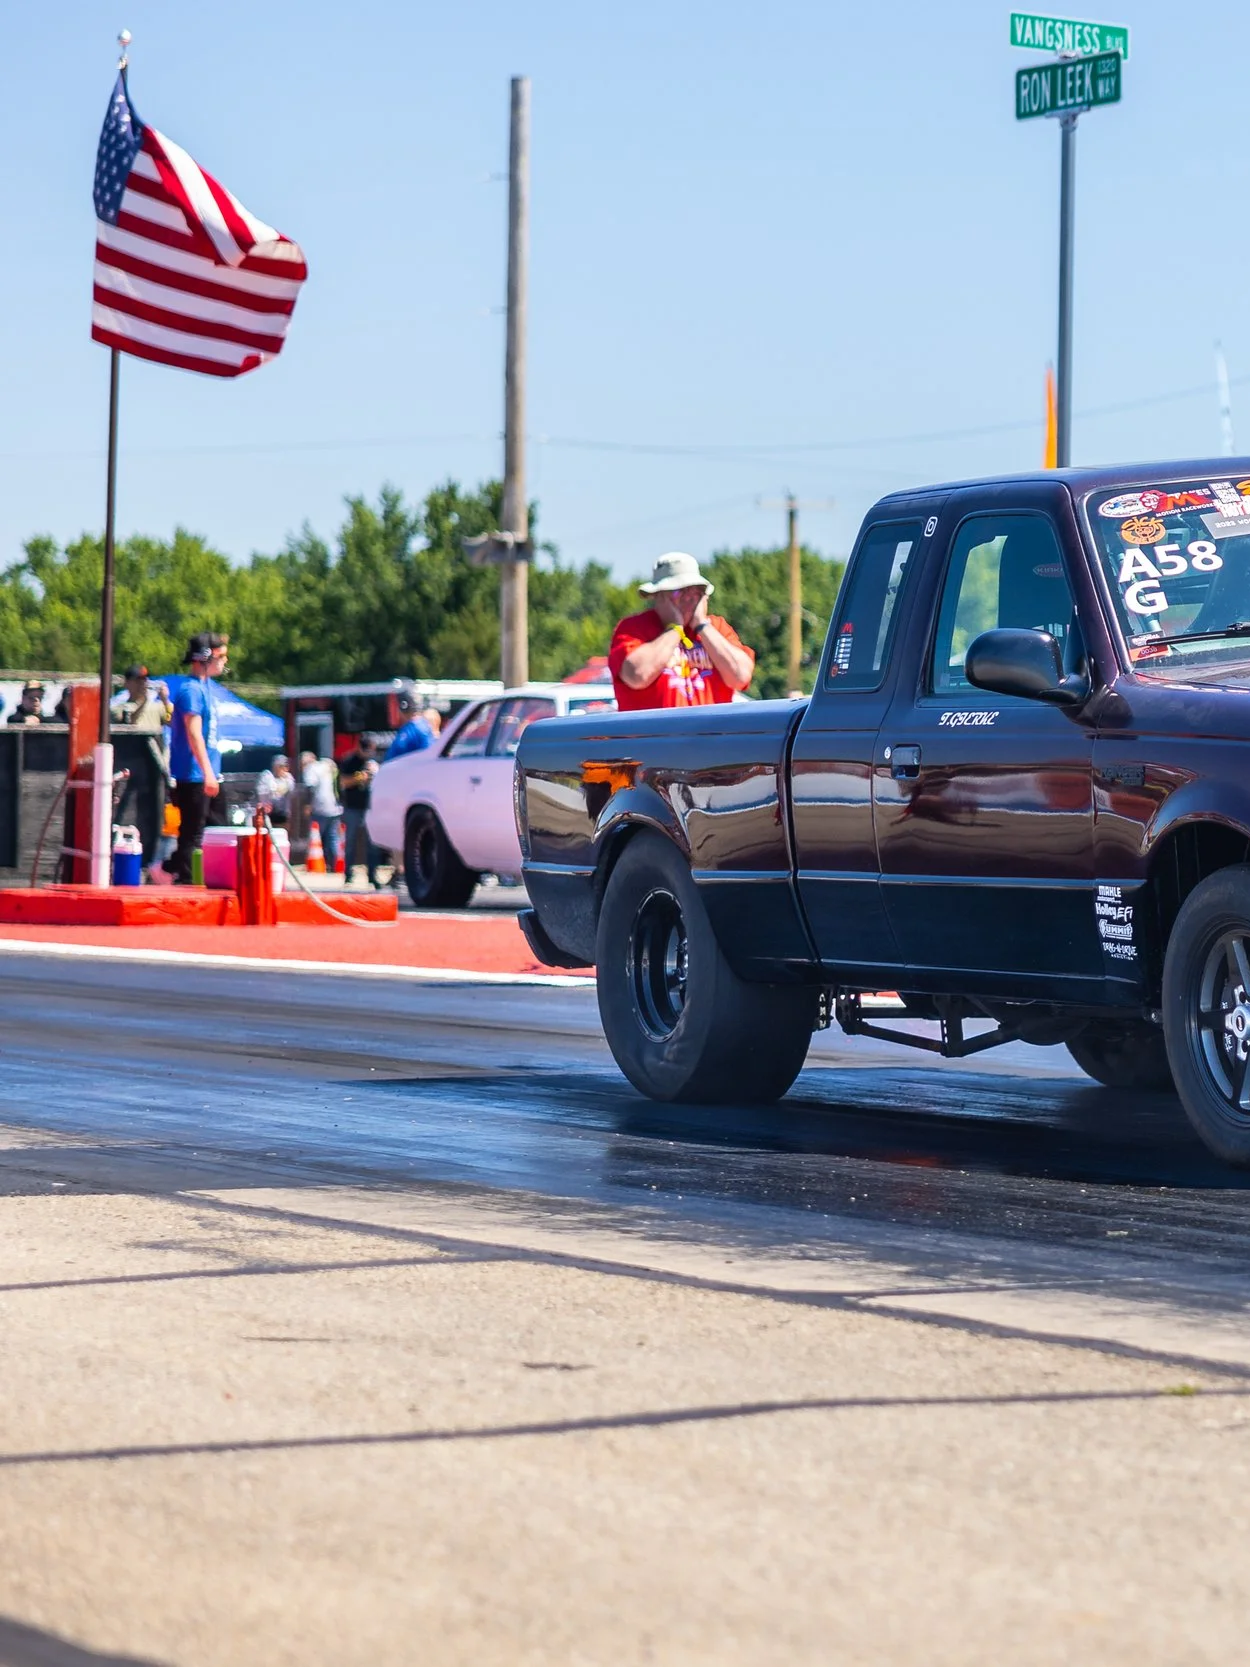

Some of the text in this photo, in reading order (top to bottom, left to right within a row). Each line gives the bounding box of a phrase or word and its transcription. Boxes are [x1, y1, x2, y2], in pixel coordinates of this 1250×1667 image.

[1014, 16, 1101, 55] VANGSNESS
[1020, 62, 1117, 113] RON LEEK WAY
[1155, 508, 1181, 517] MOTION
[1118, 541, 1224, 583] A58
[1124, 579, 1169, 615] G
[1098, 885, 1122, 898] MAHLE
[1095, 902, 1117, 920] Holley
